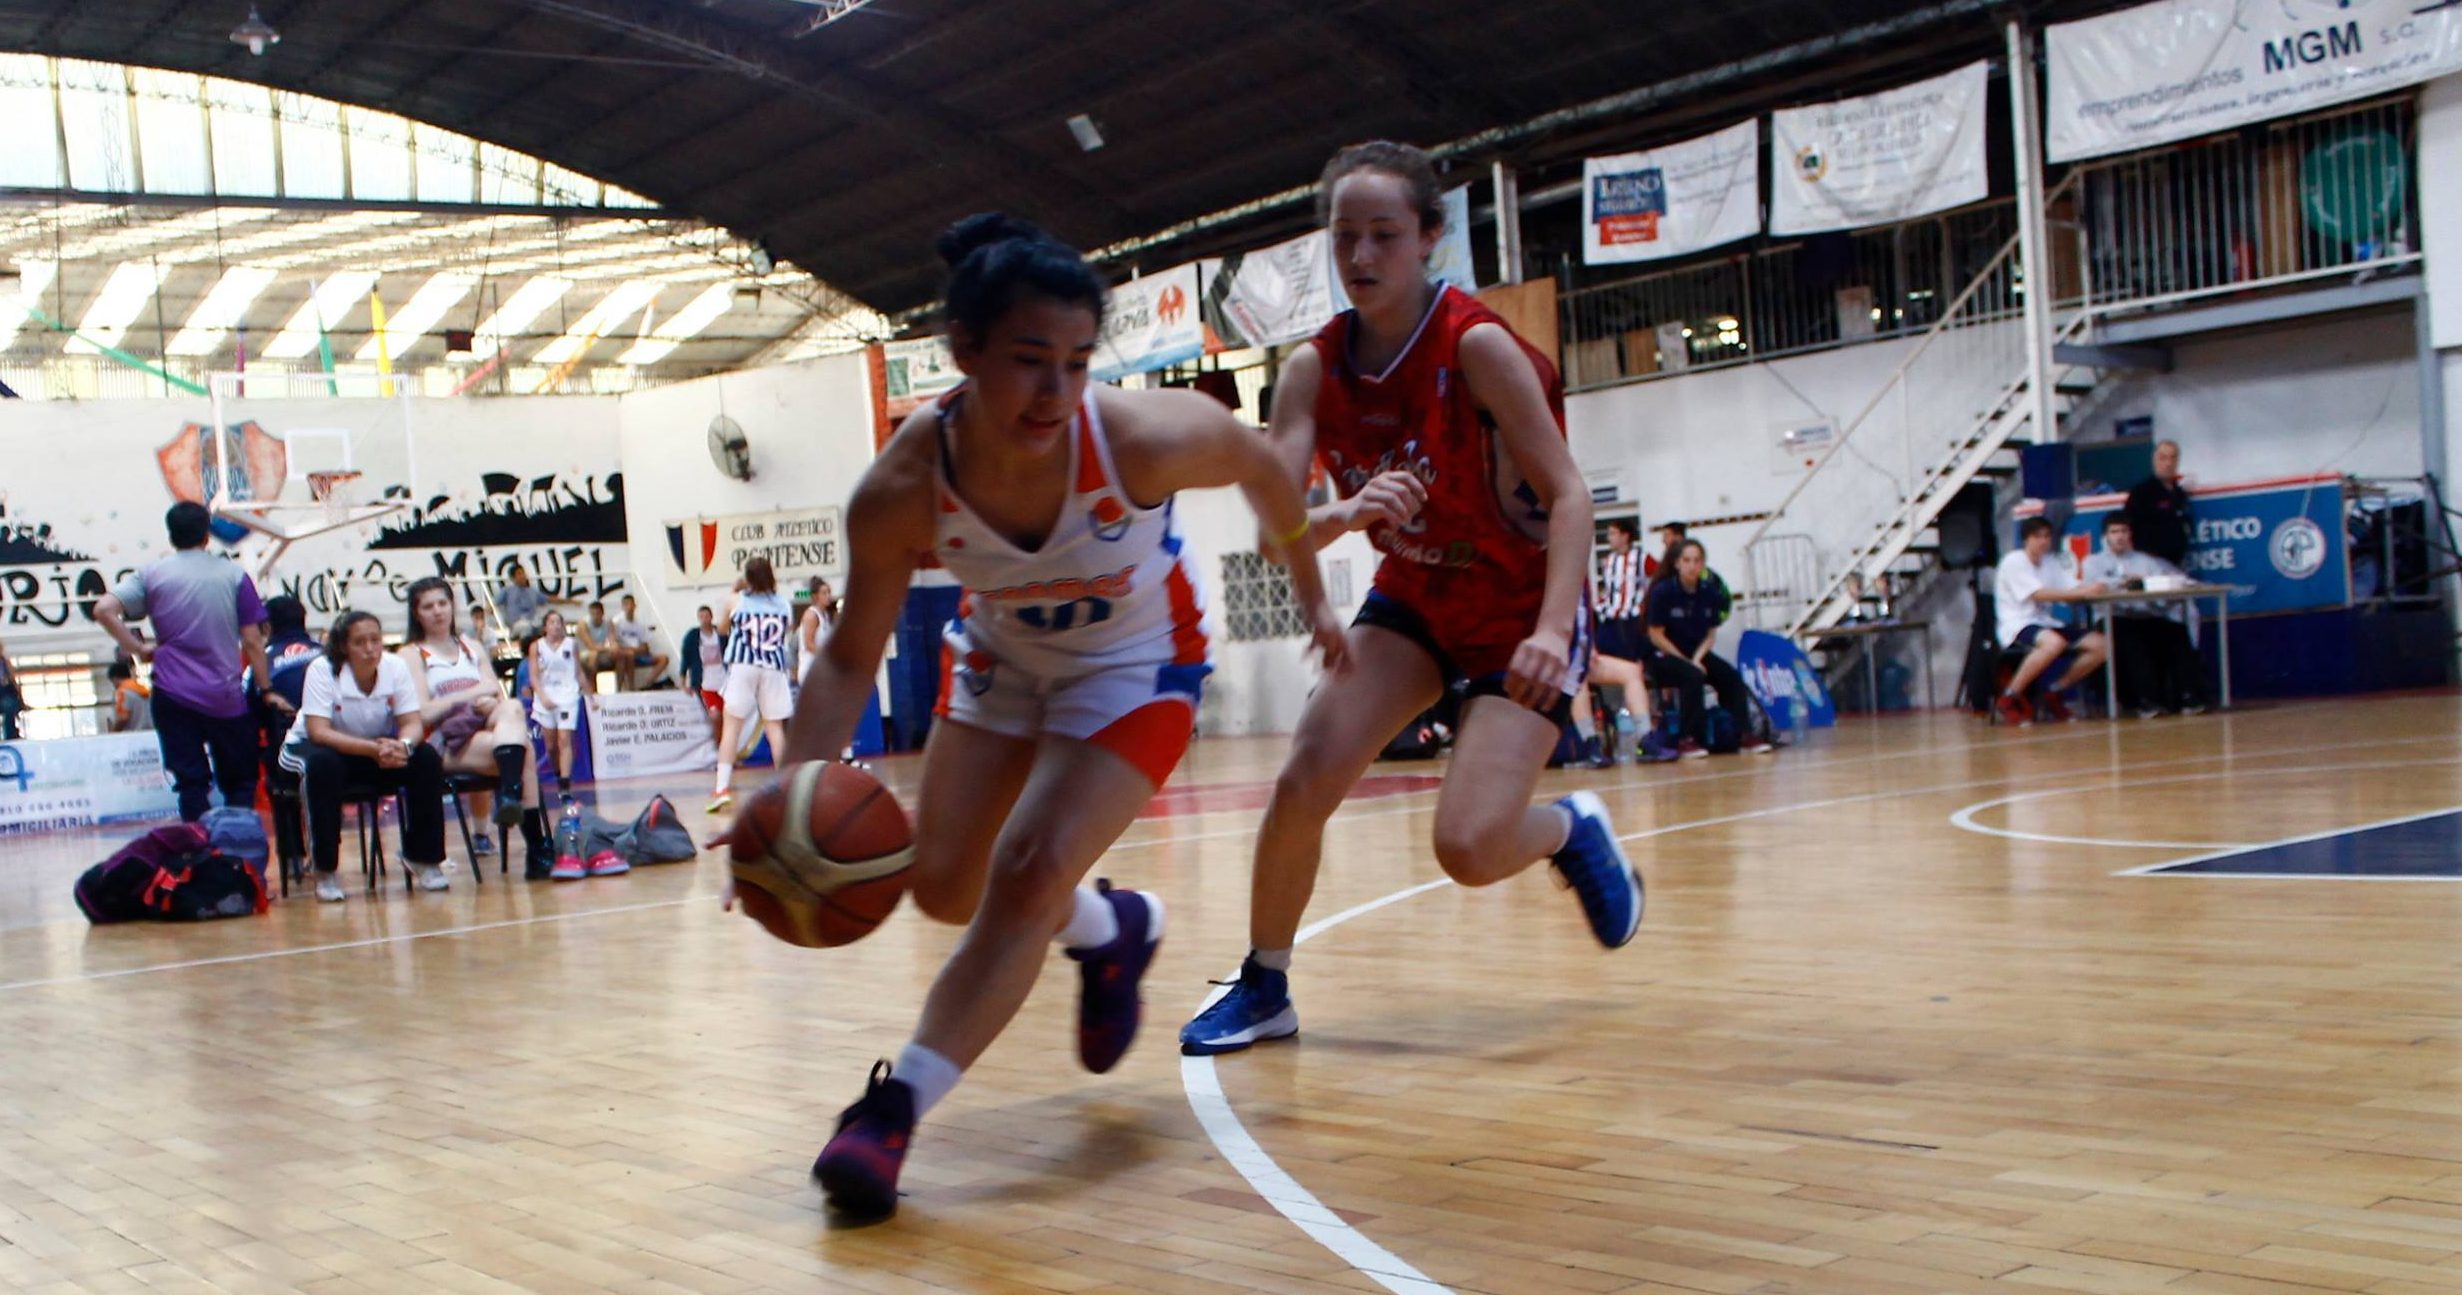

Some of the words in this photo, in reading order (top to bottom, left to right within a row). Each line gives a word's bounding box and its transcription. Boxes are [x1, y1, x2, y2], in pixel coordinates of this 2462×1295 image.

[2263, 20, 2362, 75] MGM
[731, 524, 765, 542] CLUB
[2188, 516, 2263, 545] ÉTICO
[740, 615, 785, 652] 12
